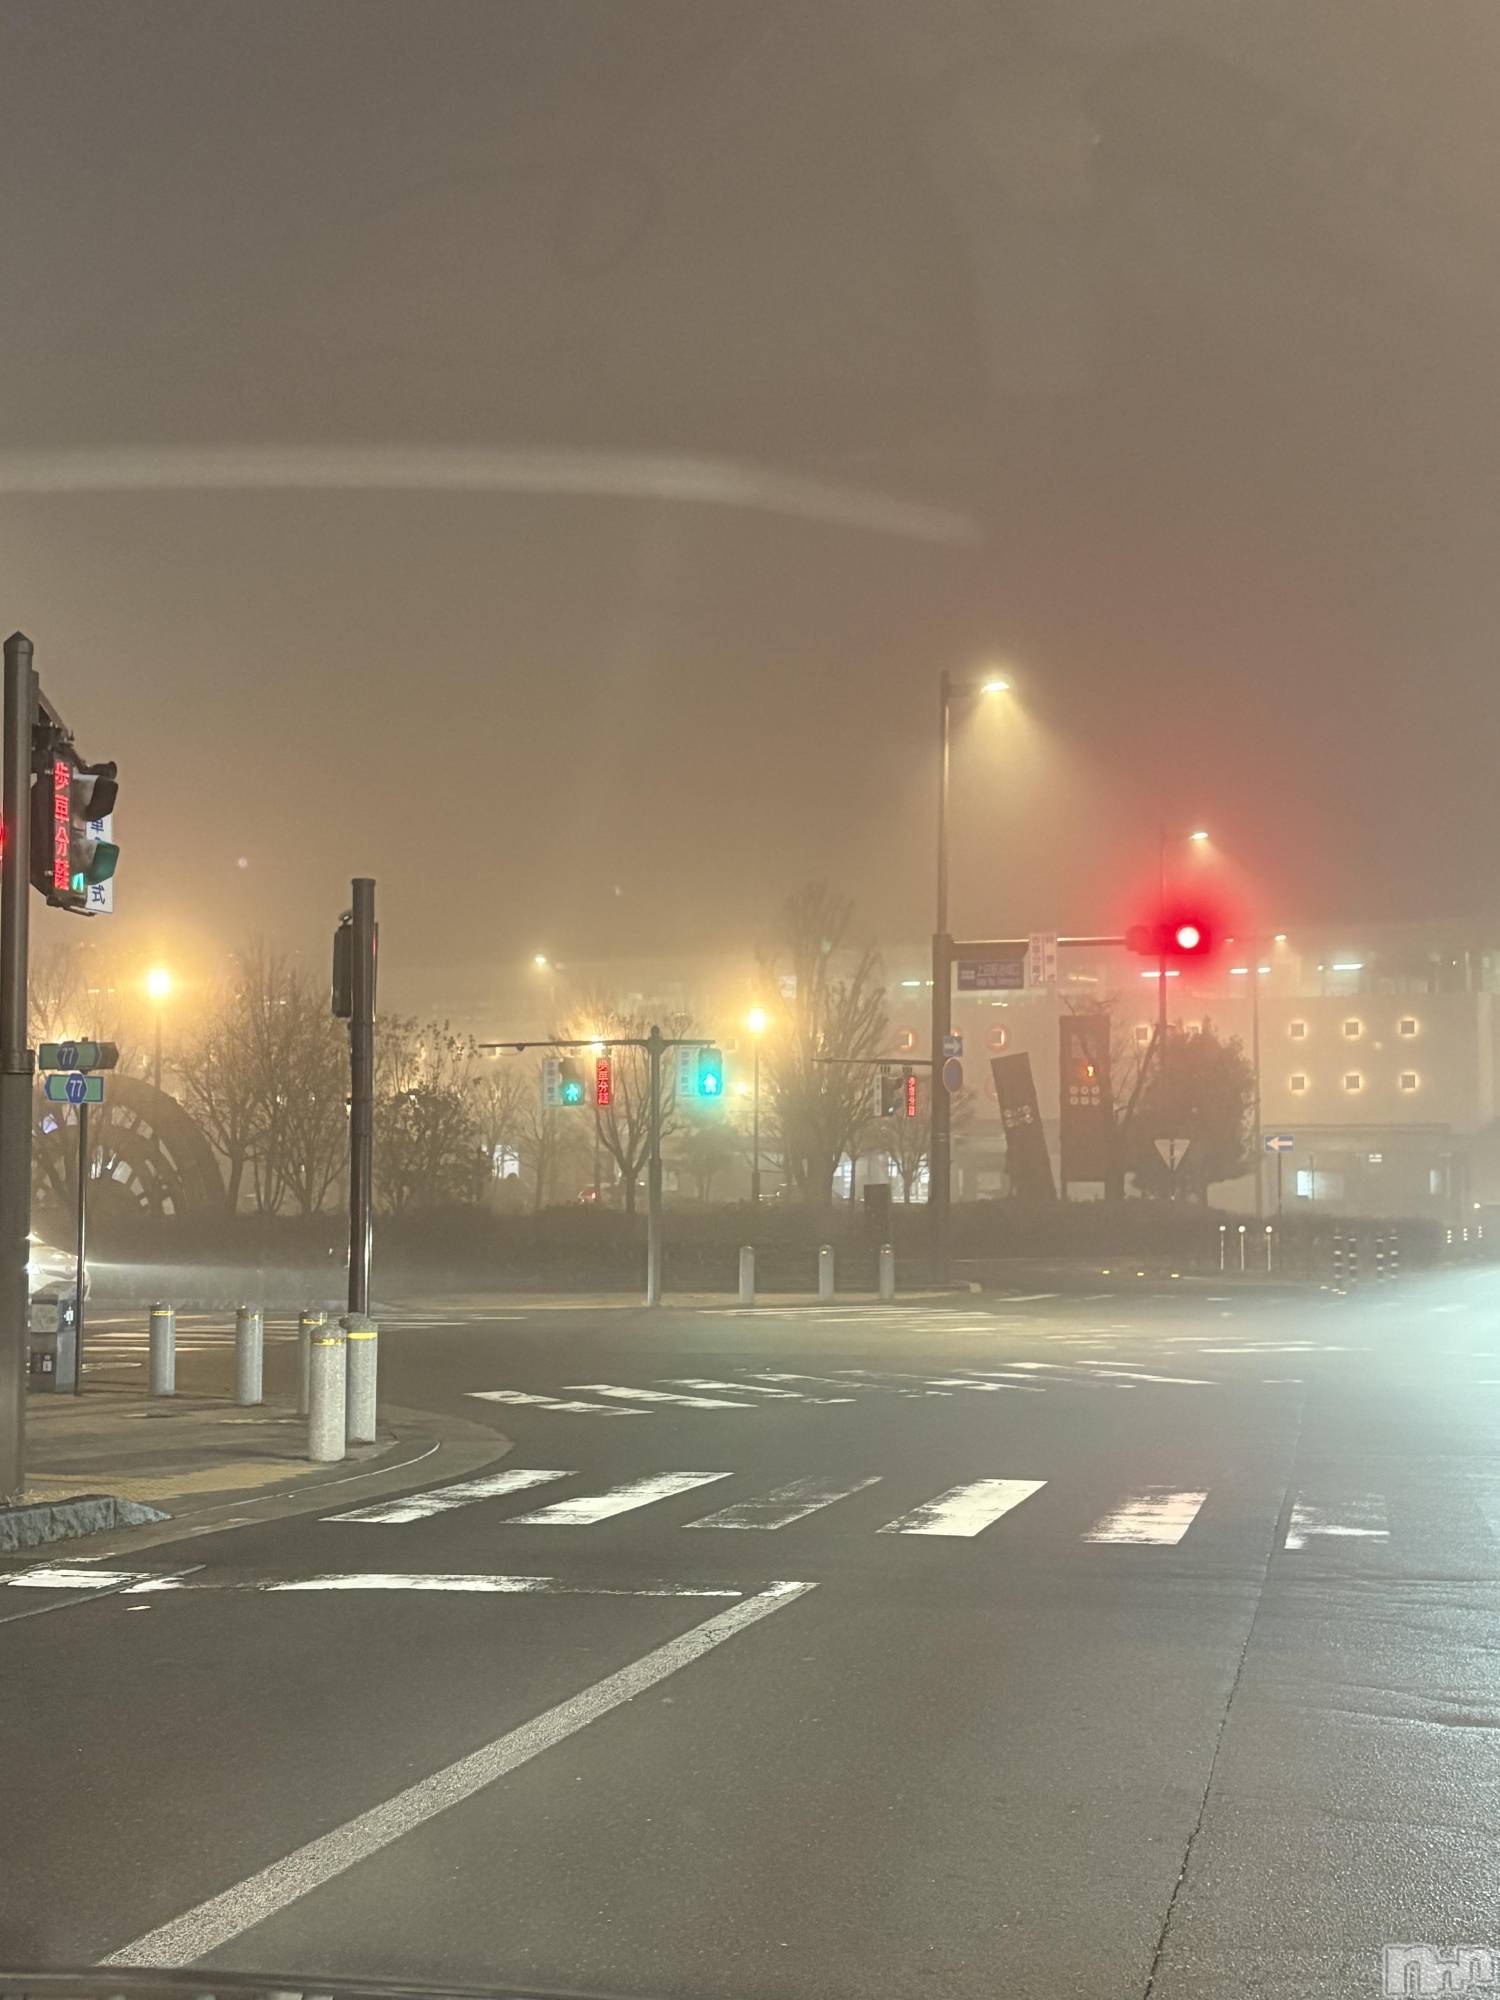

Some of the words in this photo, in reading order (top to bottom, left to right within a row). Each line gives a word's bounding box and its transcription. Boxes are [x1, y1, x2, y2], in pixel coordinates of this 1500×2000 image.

[54, 762, 70, 891] 歩車分離
[61, 1047, 75, 1066] 77
[70, 1080, 83, 1098] 77
